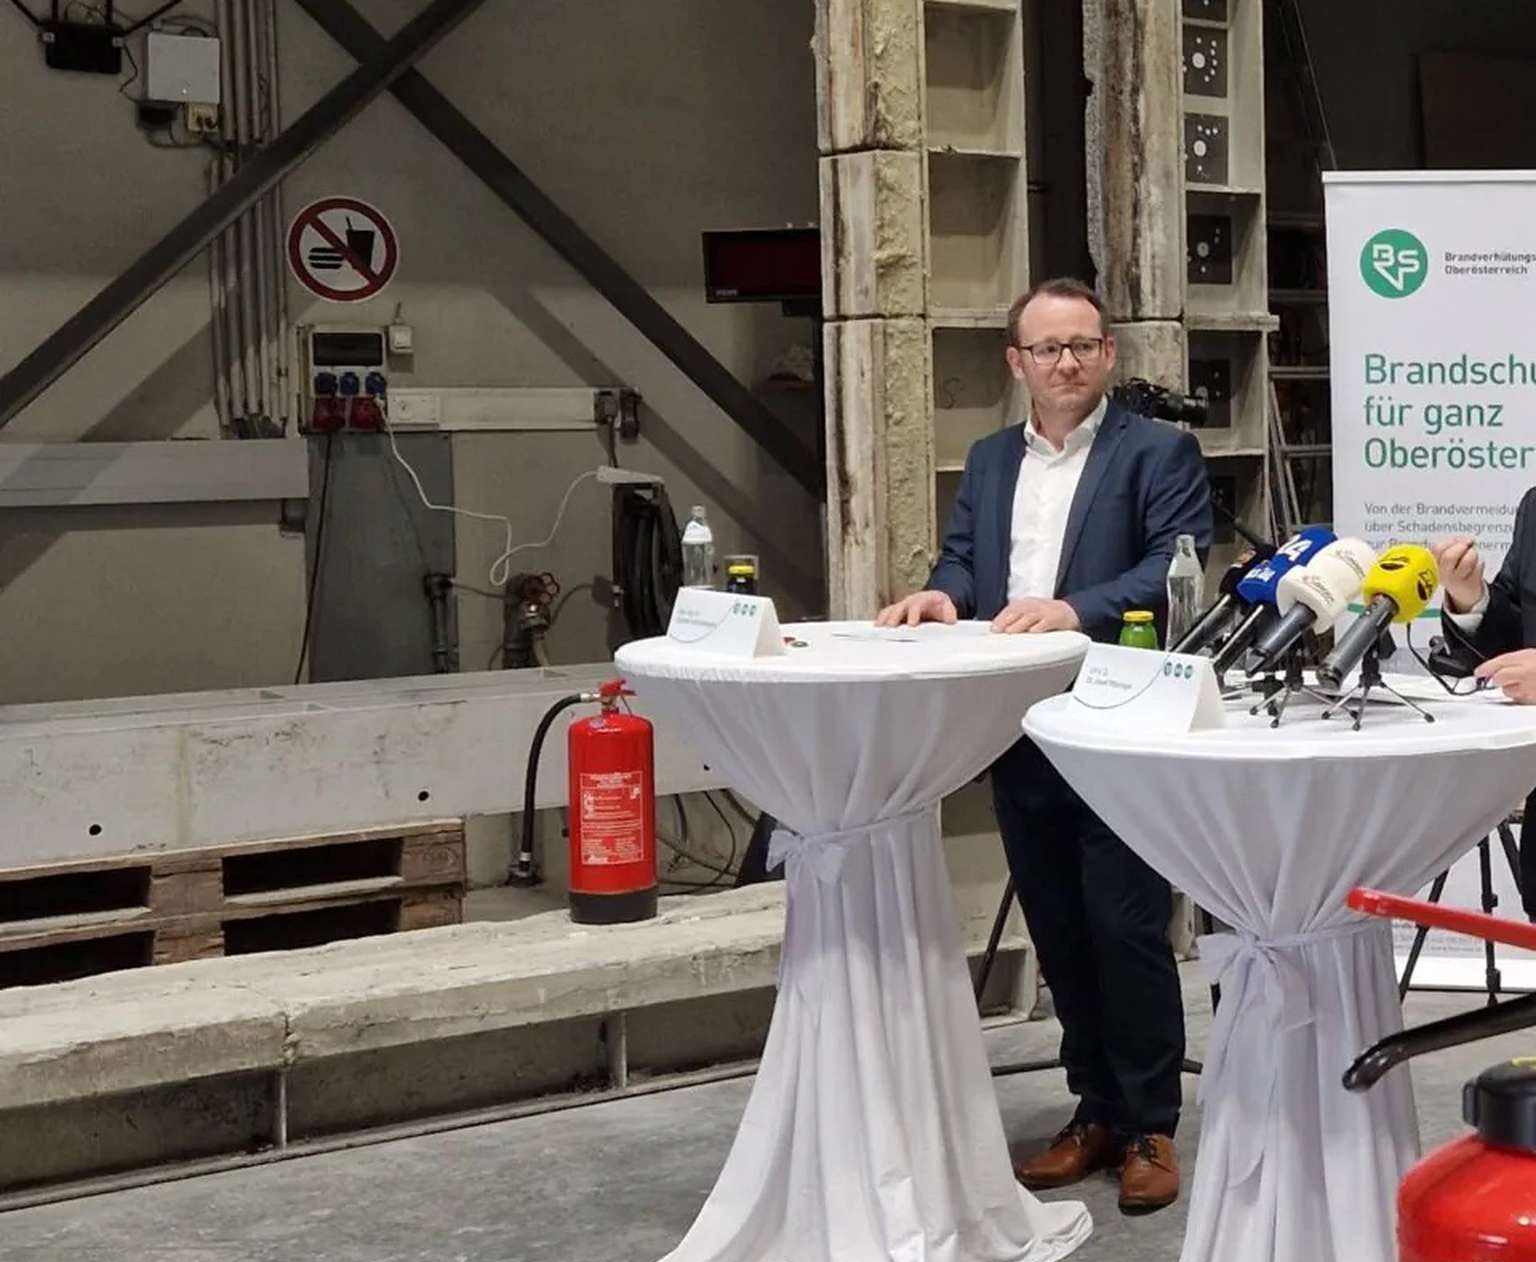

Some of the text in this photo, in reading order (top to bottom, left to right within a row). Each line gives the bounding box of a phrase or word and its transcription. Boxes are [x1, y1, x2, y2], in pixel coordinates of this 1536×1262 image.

[1444, 264, 1528, 275] Oberösterreich
[1364, 395, 1504, 436] für ganz
[1364, 503, 1388, 515] Von
[1391, 503, 1412, 515] der
[1364, 520, 1393, 533] über
